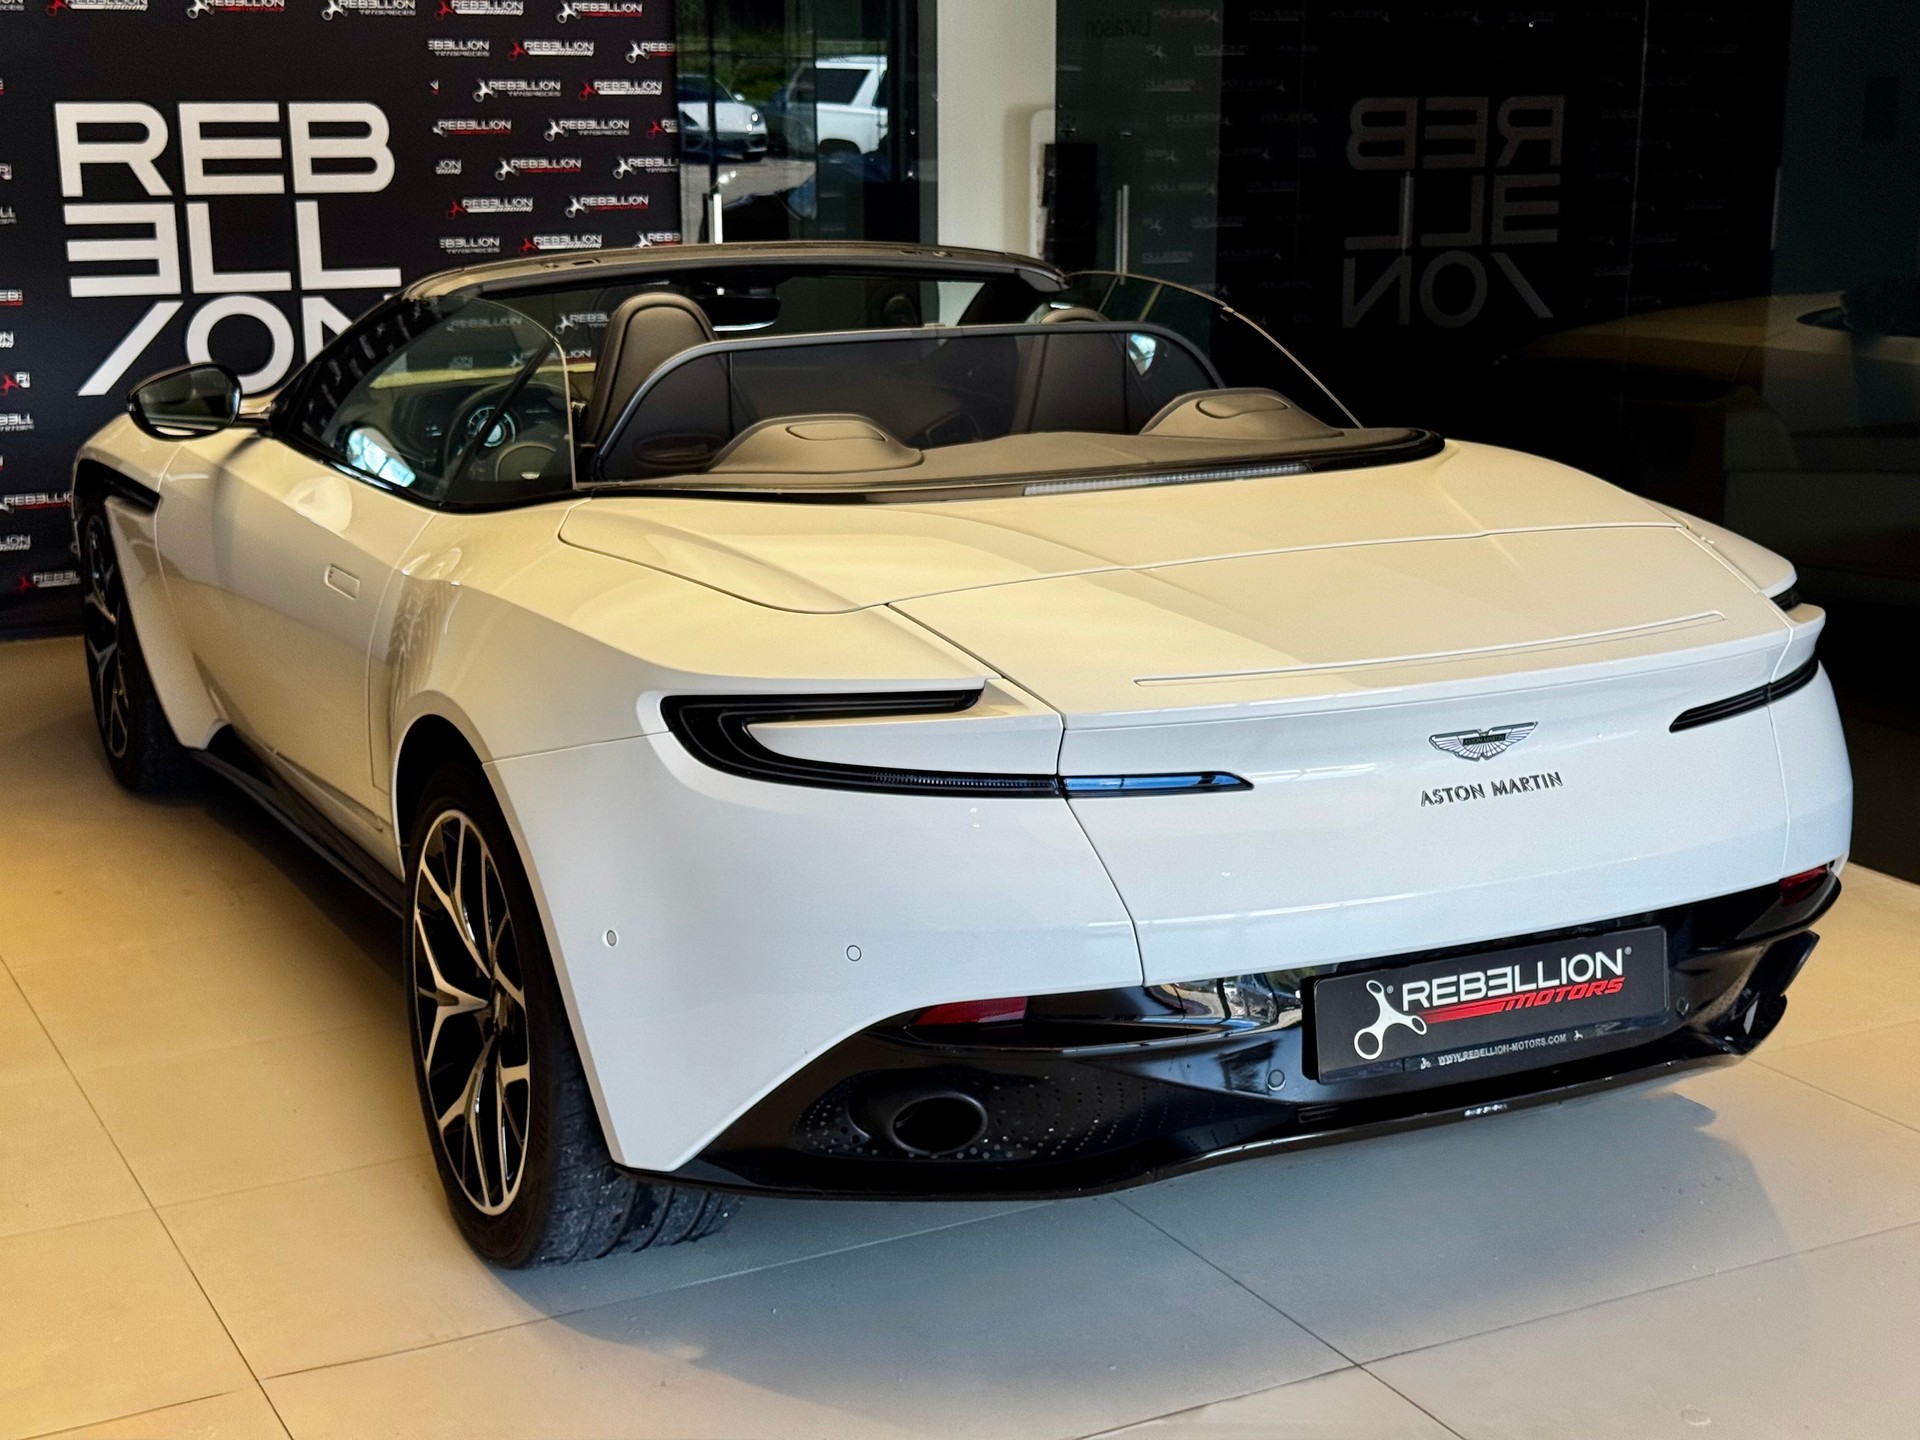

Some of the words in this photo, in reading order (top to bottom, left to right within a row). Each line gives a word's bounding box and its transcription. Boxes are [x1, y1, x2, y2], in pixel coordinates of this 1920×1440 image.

[339, 0, 416, 9] REBELLION
[451, 0, 524, 10] REBELLION
[571, 2, 643, 13] REBELLION
[523, 41, 594, 51] REBELLION
[488, 80, 561, 91] REBELLION
[594, 80, 663, 91] REBELLION
[438, 120, 512, 130] REBELLION
[560, 119, 630, 130] REBELLION
[54, 102, 395, 197] REB
[510, 158, 582, 169] REBELLION
[462, 197, 534, 209] REBELLION
[580, 195, 649, 206] REBELLION
[533, 234, 602, 246] REBELLION
[1421, 783, 1485, 807] ASTON
[1491, 771, 1563, 797] MARTIN
[1402, 948, 1623, 1012] REBELLION
[1501, 976, 1626, 1011] MOTORS
